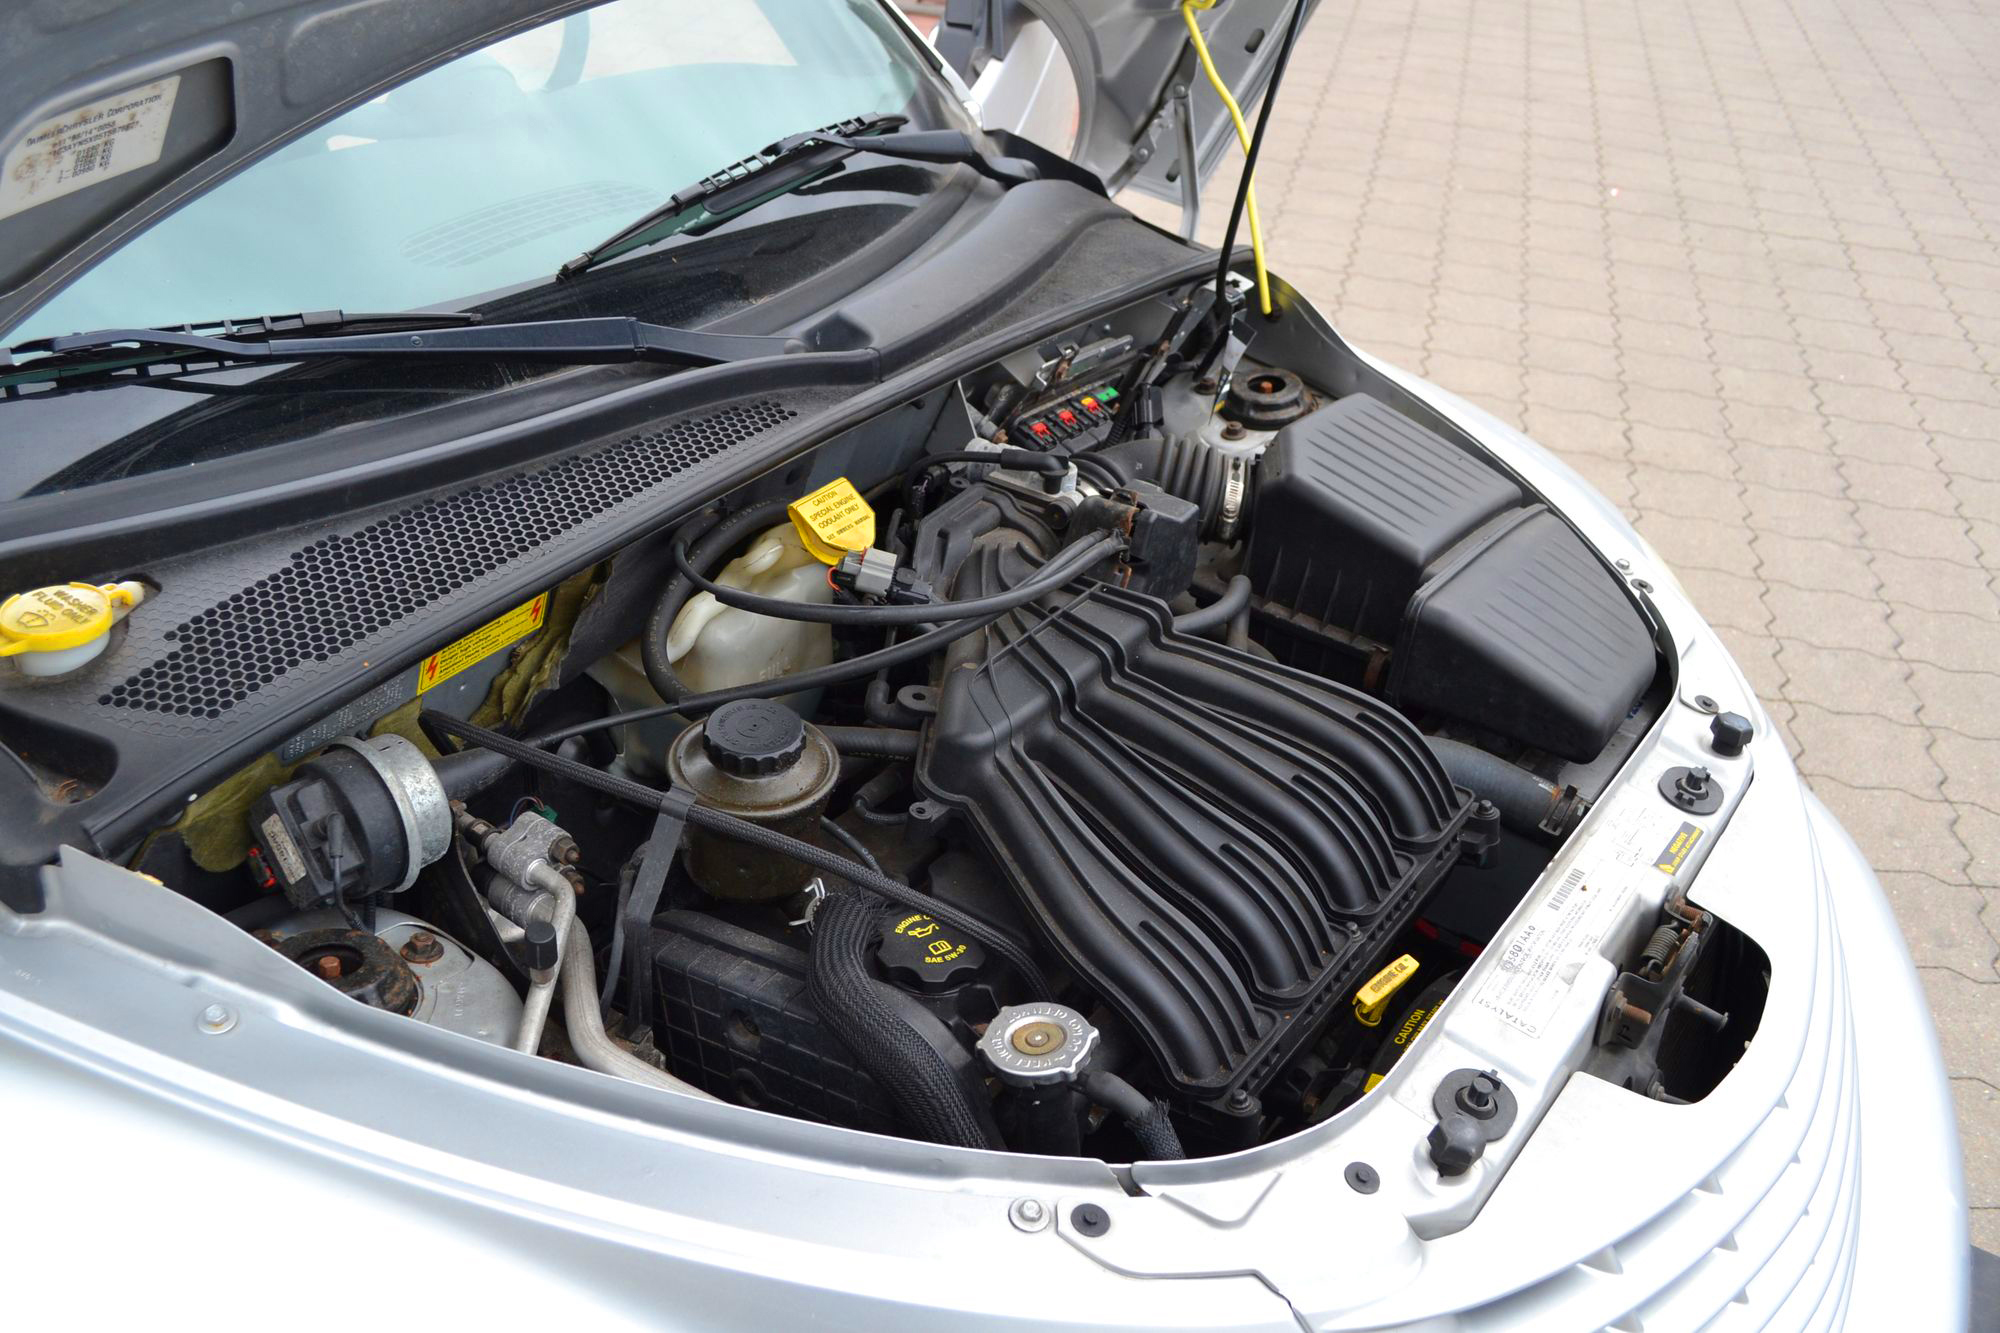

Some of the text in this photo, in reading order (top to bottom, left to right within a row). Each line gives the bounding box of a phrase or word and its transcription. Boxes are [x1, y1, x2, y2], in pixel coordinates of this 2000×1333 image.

[809, 493, 856, 522] SPECIAL ENGINE
[812, 490, 838, 506] CAUTION
[818, 503, 860, 529] COOLANT ONLY
[32, 590, 93, 624] FLUID ONLY
[53, 590, 98, 616] WASHER
[895, 914, 922, 934] ENGINE
[1394, 1009, 1425, 1044] CAUTION
[1478, 998, 1537, 1034] CATALYST
